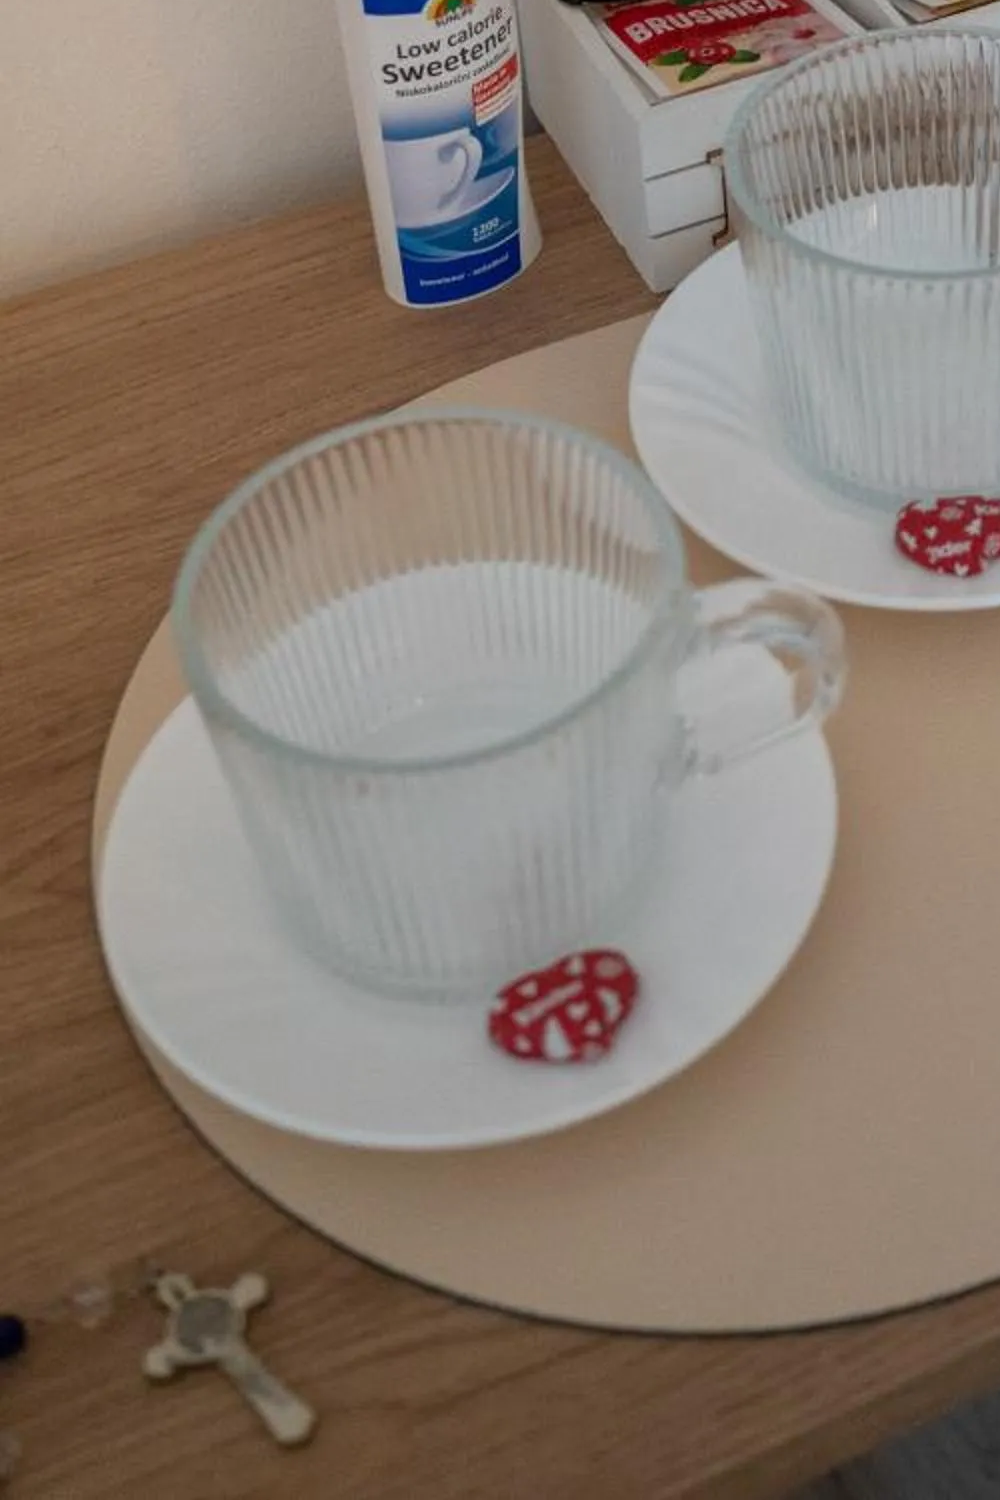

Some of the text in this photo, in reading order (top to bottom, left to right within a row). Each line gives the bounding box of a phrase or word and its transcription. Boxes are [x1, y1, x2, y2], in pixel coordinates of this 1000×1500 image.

[381, 16, 513, 85] Sweetener
[396, 6, 503, 59] Low calorie
